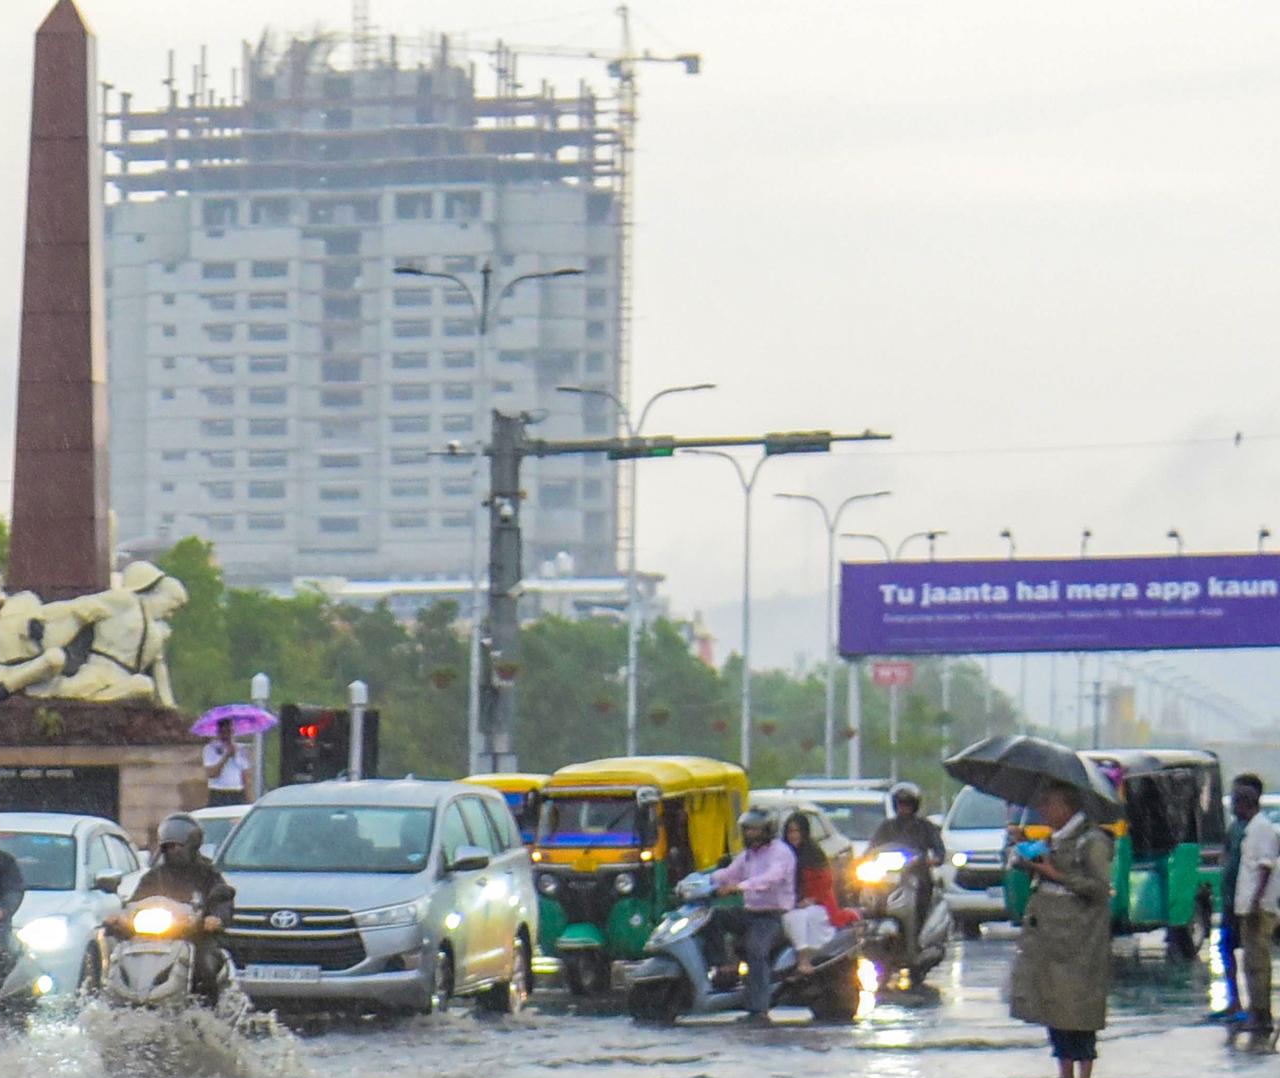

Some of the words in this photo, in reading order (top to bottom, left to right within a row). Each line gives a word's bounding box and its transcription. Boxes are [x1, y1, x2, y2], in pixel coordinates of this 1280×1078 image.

[879, 584, 915, 604] Tu
[921, 583, 1009, 606] jaanta
[1016, 580, 1059, 601] hai
[1066, 583, 1138, 600] mera
[1146, 581, 1200, 601] app
[1207, 576, 1278, 598] kaun
